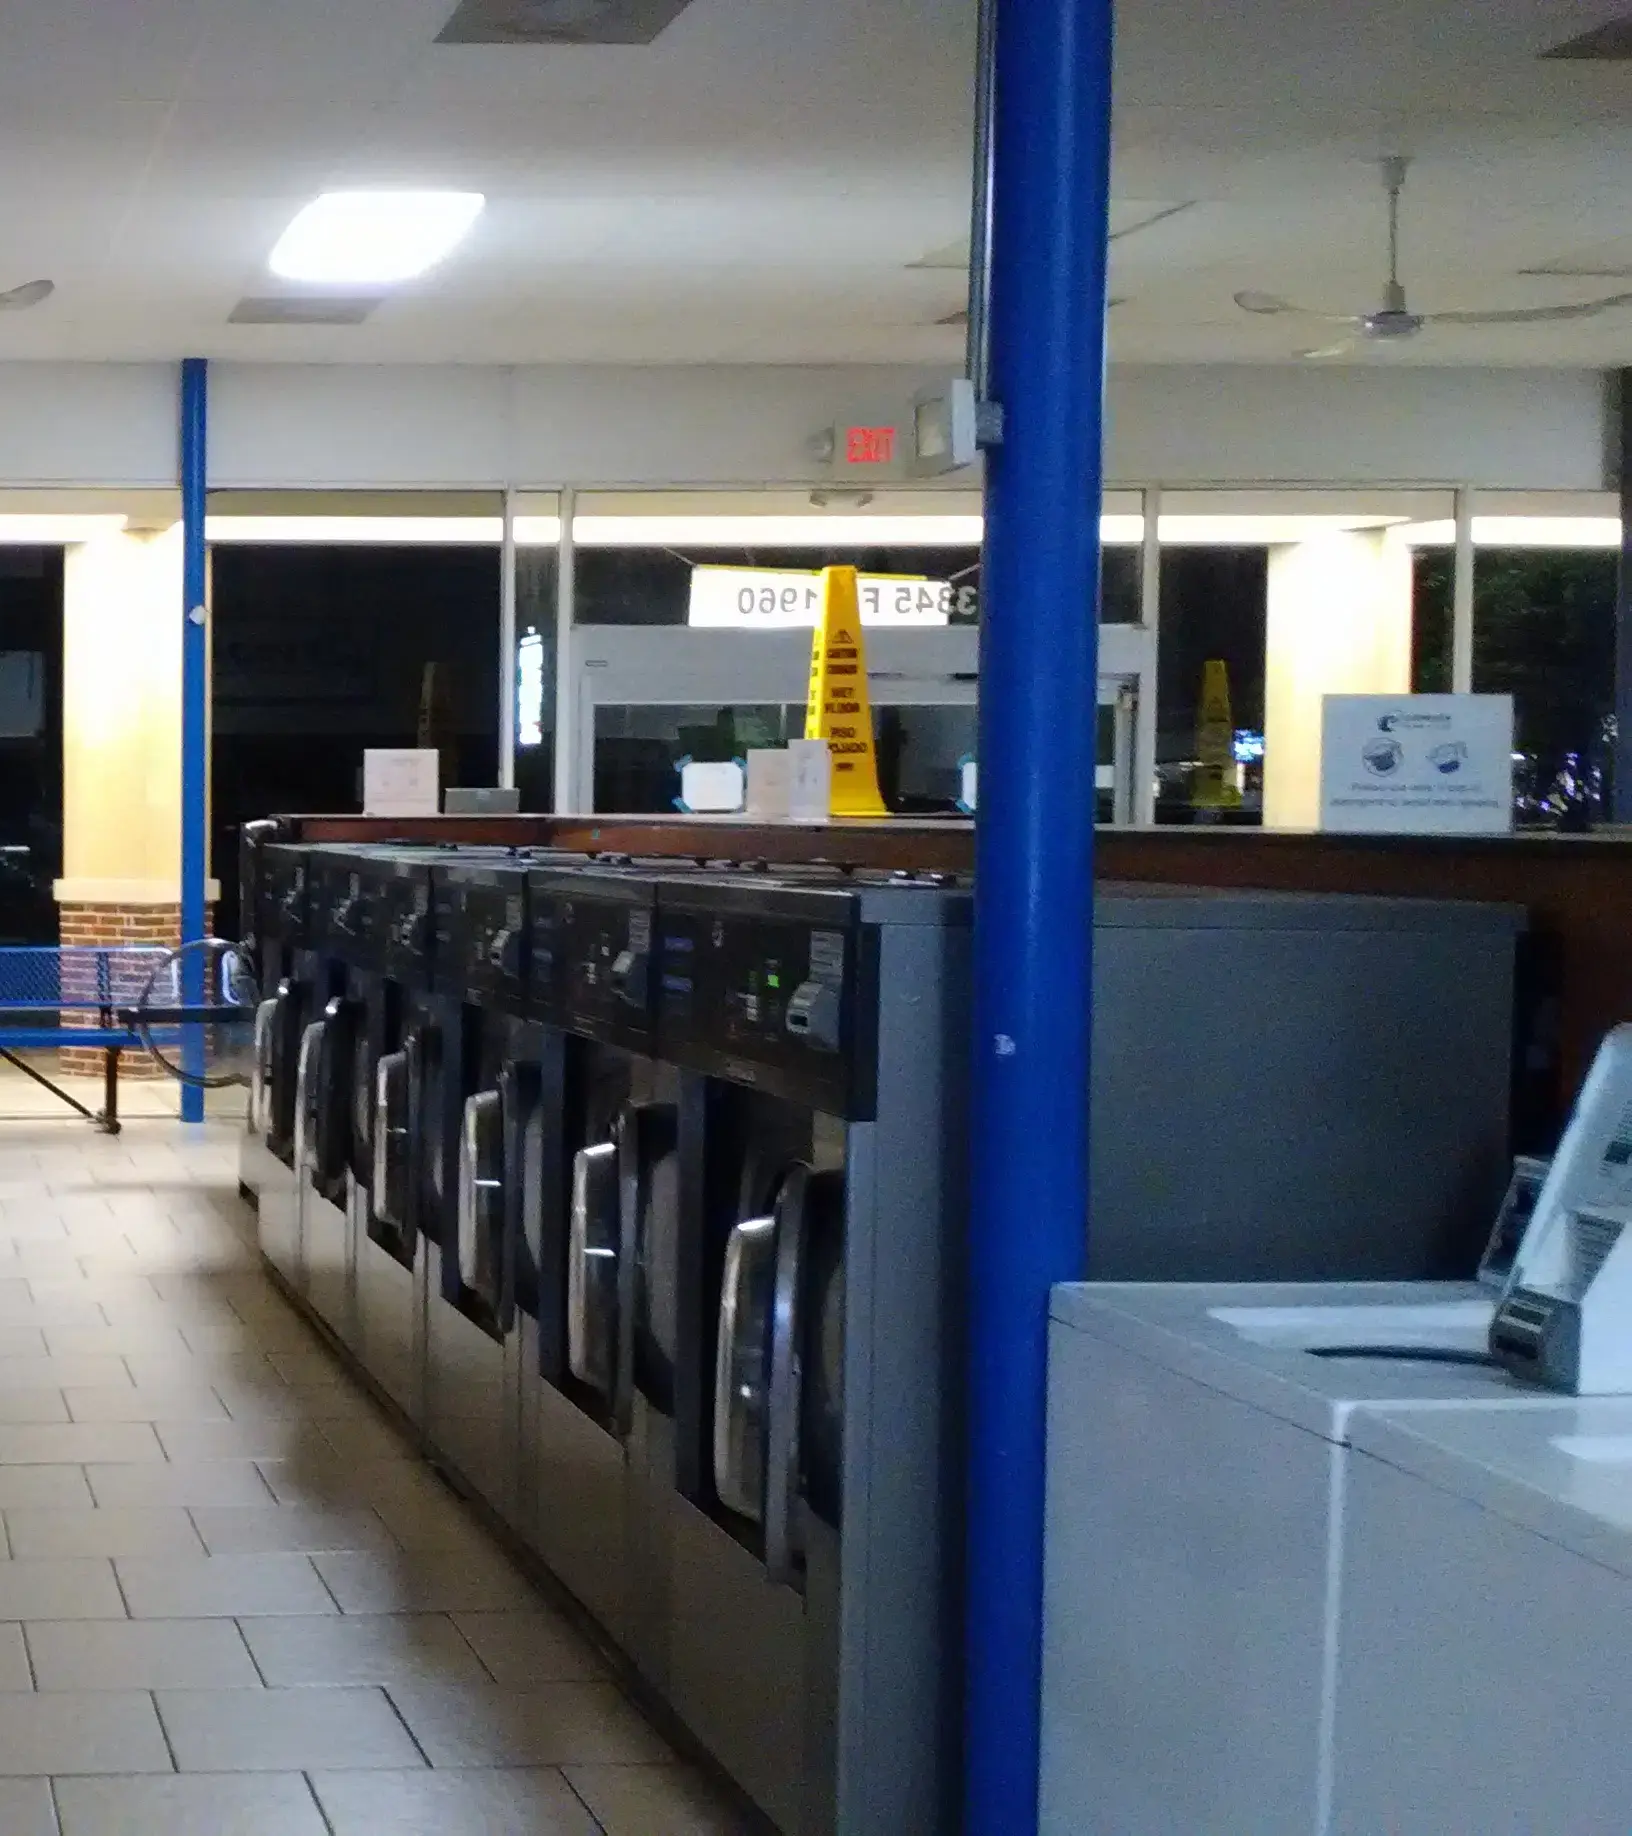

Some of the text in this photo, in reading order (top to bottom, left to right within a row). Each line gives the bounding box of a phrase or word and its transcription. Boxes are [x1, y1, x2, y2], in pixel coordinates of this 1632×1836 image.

[846, 426, 895, 464] EXIT
[831, 686, 855, 699] WET
[830, 726, 856, 738] PISO
